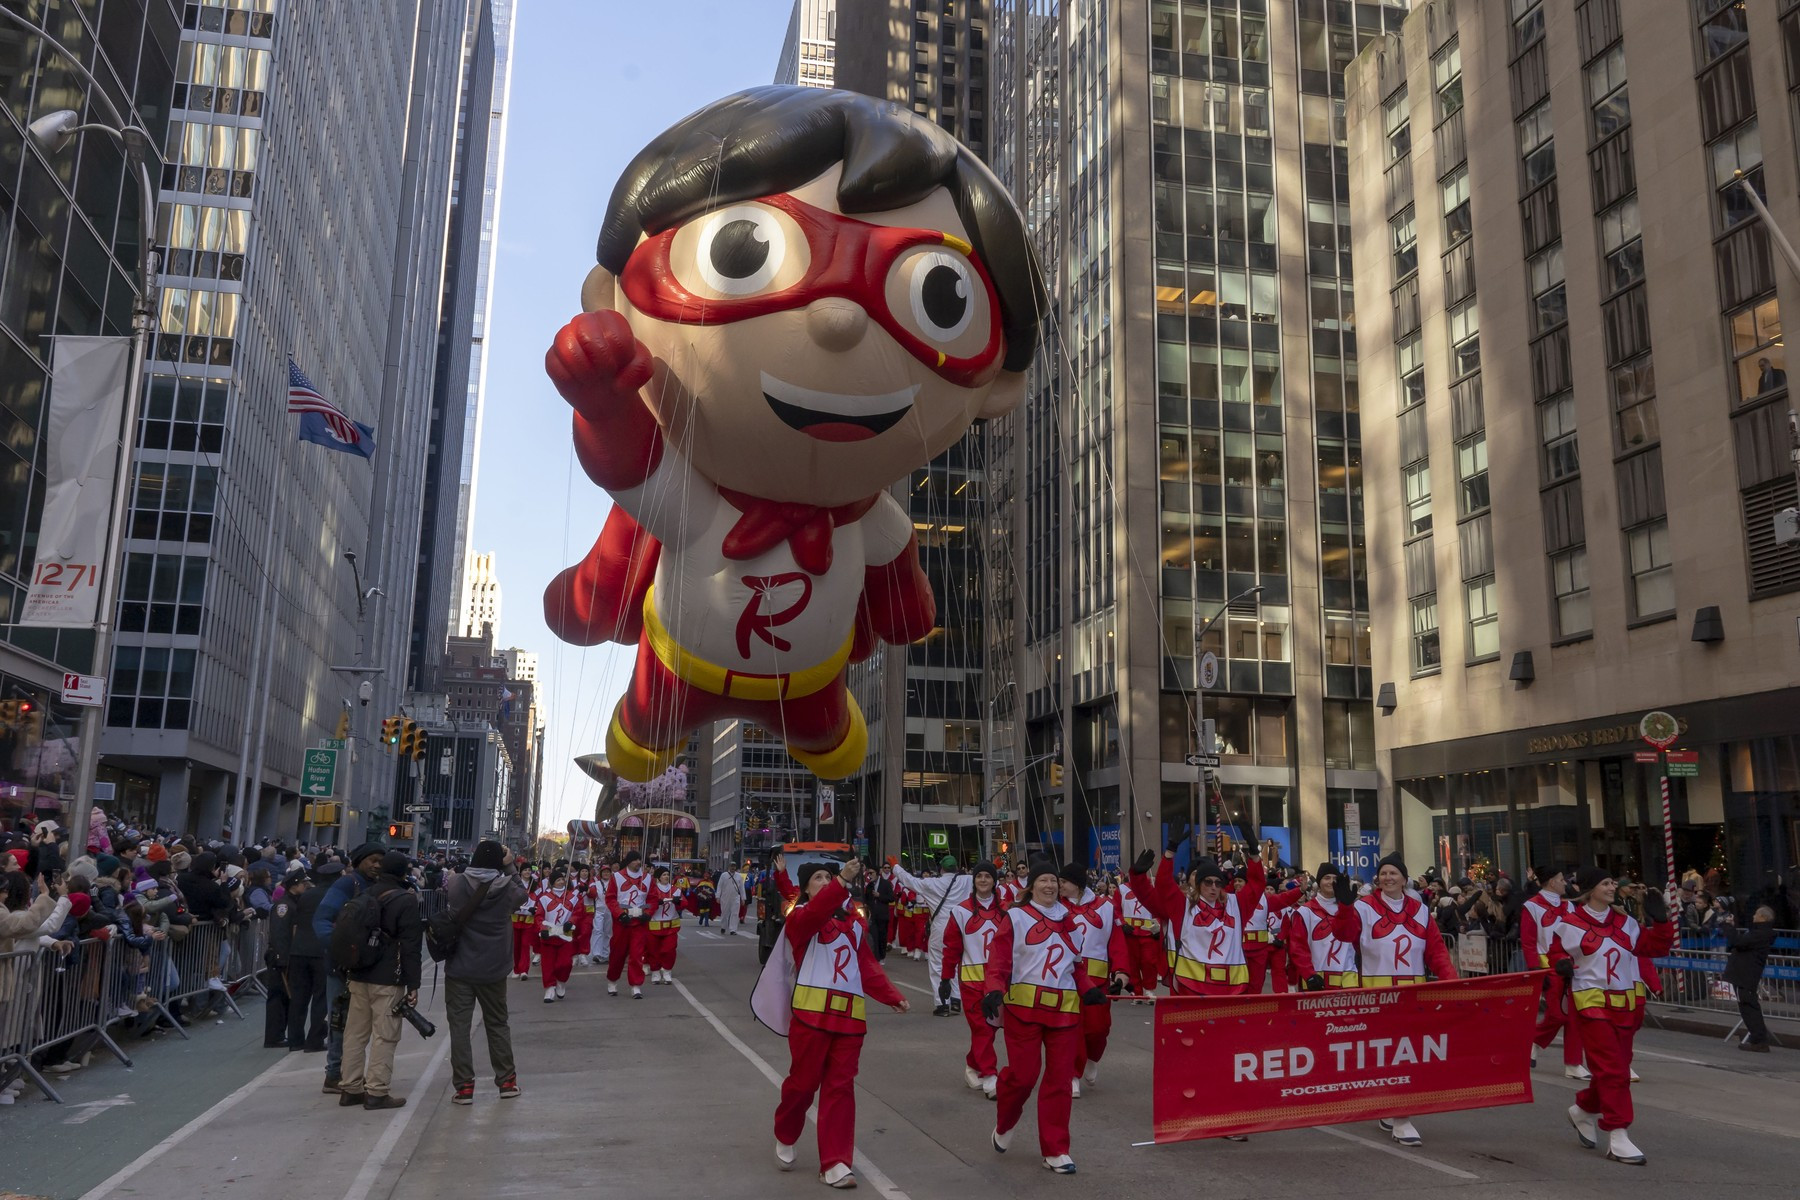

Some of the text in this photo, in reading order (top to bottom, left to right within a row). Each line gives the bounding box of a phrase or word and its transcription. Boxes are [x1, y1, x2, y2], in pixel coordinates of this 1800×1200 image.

[34, 563, 97, 591] 1271
[735, 572, 812, 660] R
[1528, 716, 1688, 754] BROOKS BROTS
[930, 833, 947, 845] TD
[1102, 830, 1118, 840] CHASE
[628, 890, 639, 906] R
[554, 908, 565, 926] R
[1208, 926, 1226, 960] R
[1392, 934, 1412, 970] R
[833, 944, 852, 984] R
[1040, 943, 1064, 982] R
[1605, 947, 1621, 985] R
[1296, 992, 1400, 1010] THANKSGIVING DAY
[1314, 1006, 1380, 1018] PARADE
[1325, 1022, 1368, 1036] Presents
[1234, 1033, 1448, 1083] RED TITAN
